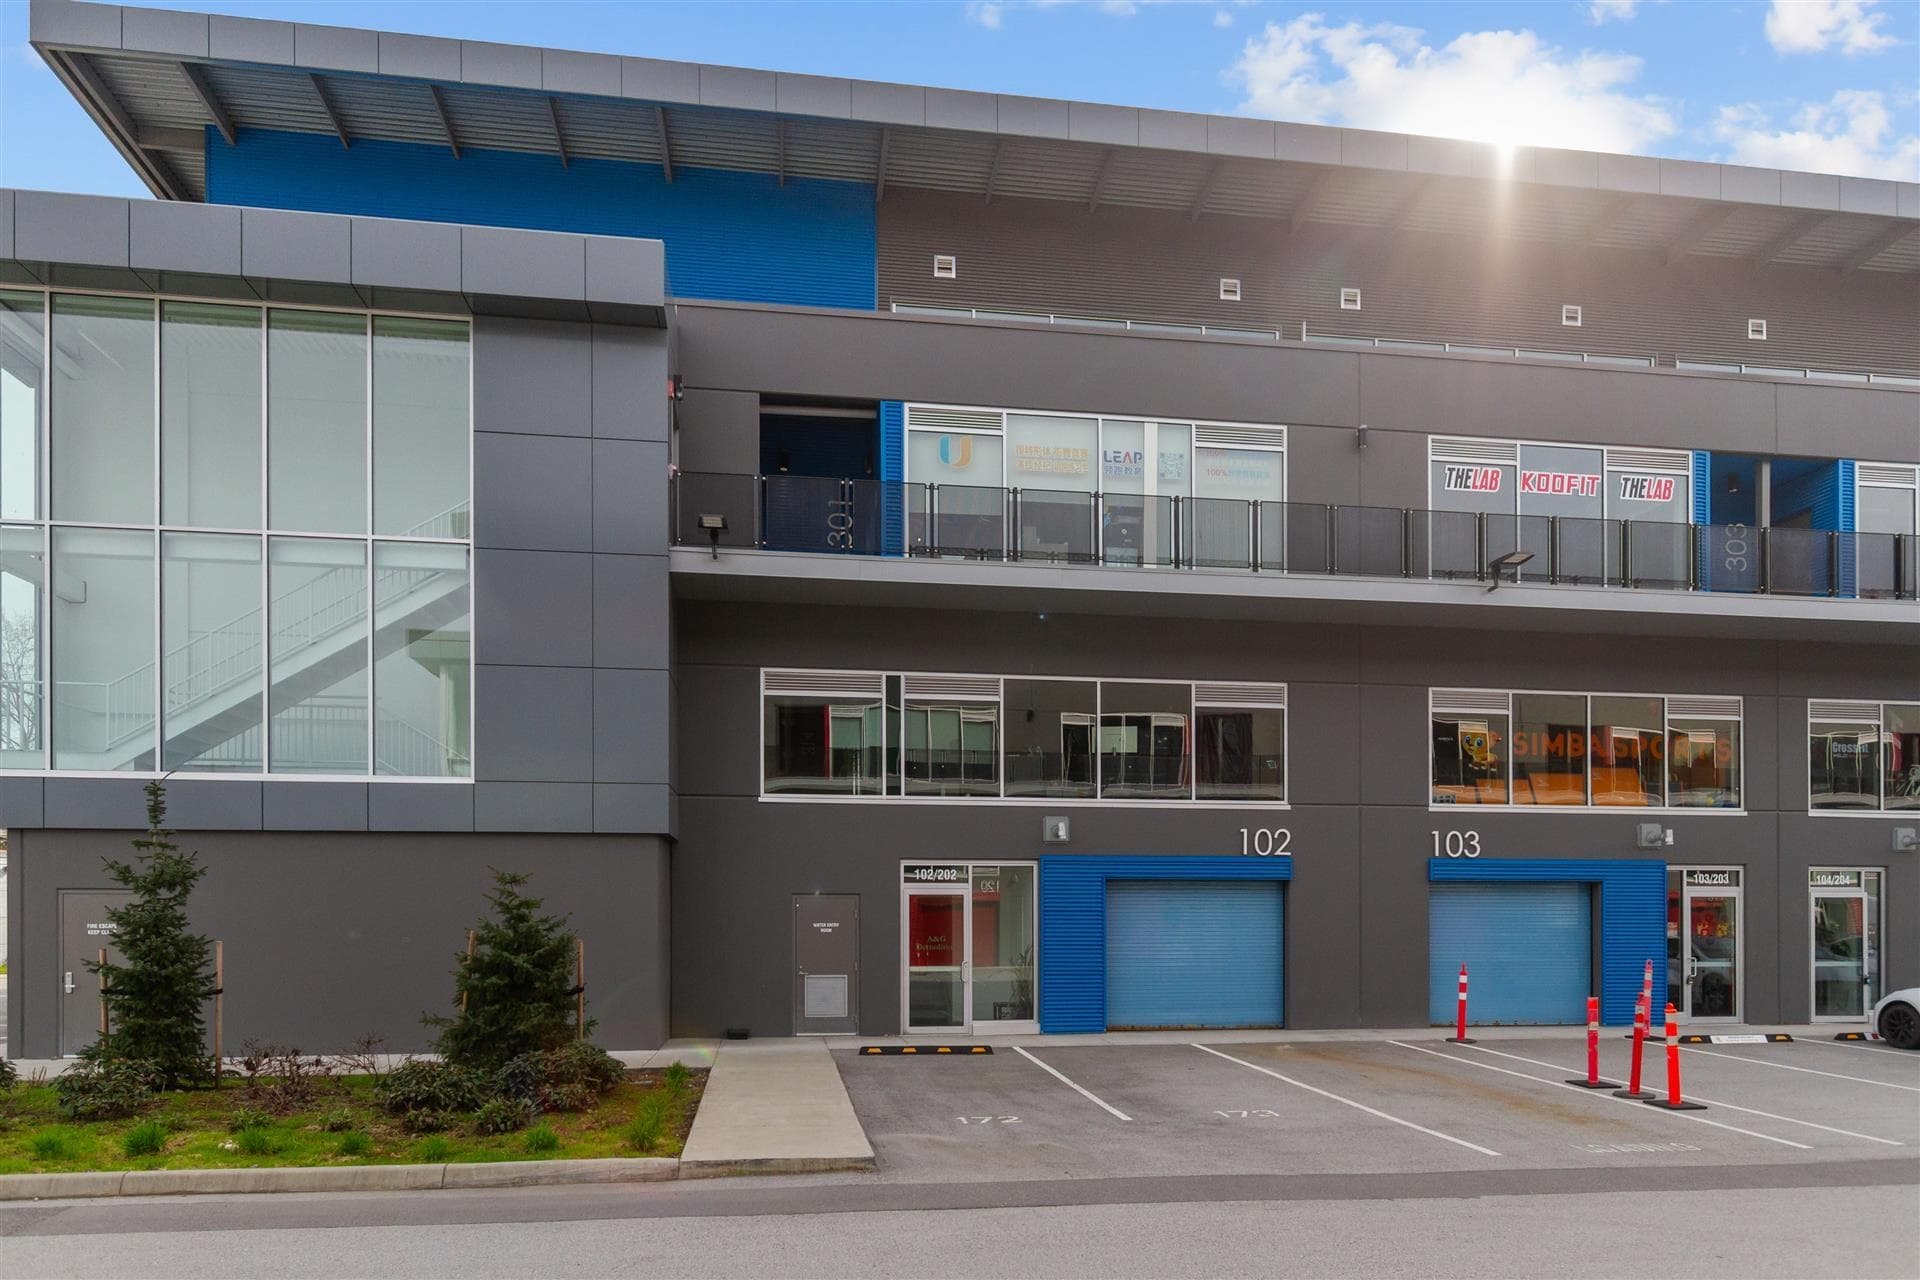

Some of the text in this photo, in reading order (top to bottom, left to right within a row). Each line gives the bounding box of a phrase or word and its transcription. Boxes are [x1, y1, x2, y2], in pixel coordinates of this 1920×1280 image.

[1103, 450, 1143, 464] LEAP
[1446, 467, 1500, 491] THELAB
[1521, 472, 1600, 496] KOOFIT
[1622, 477, 1673, 500] THELAB
[827, 500, 853, 548] 301
[1726, 523, 1747, 571] 303
[1513, 729, 1604, 759] SIMBA
[1239, 828, 1292, 856] 102
[1431, 830, 1481, 858] 103
[914, 869, 957, 881] 102/202
[1693, 873, 1729, 884] 103/203
[1815, 875, 1850, 885] 104/204
[956, 1116, 1024, 1124] 172
[1213, 1109, 1280, 1118] 173
